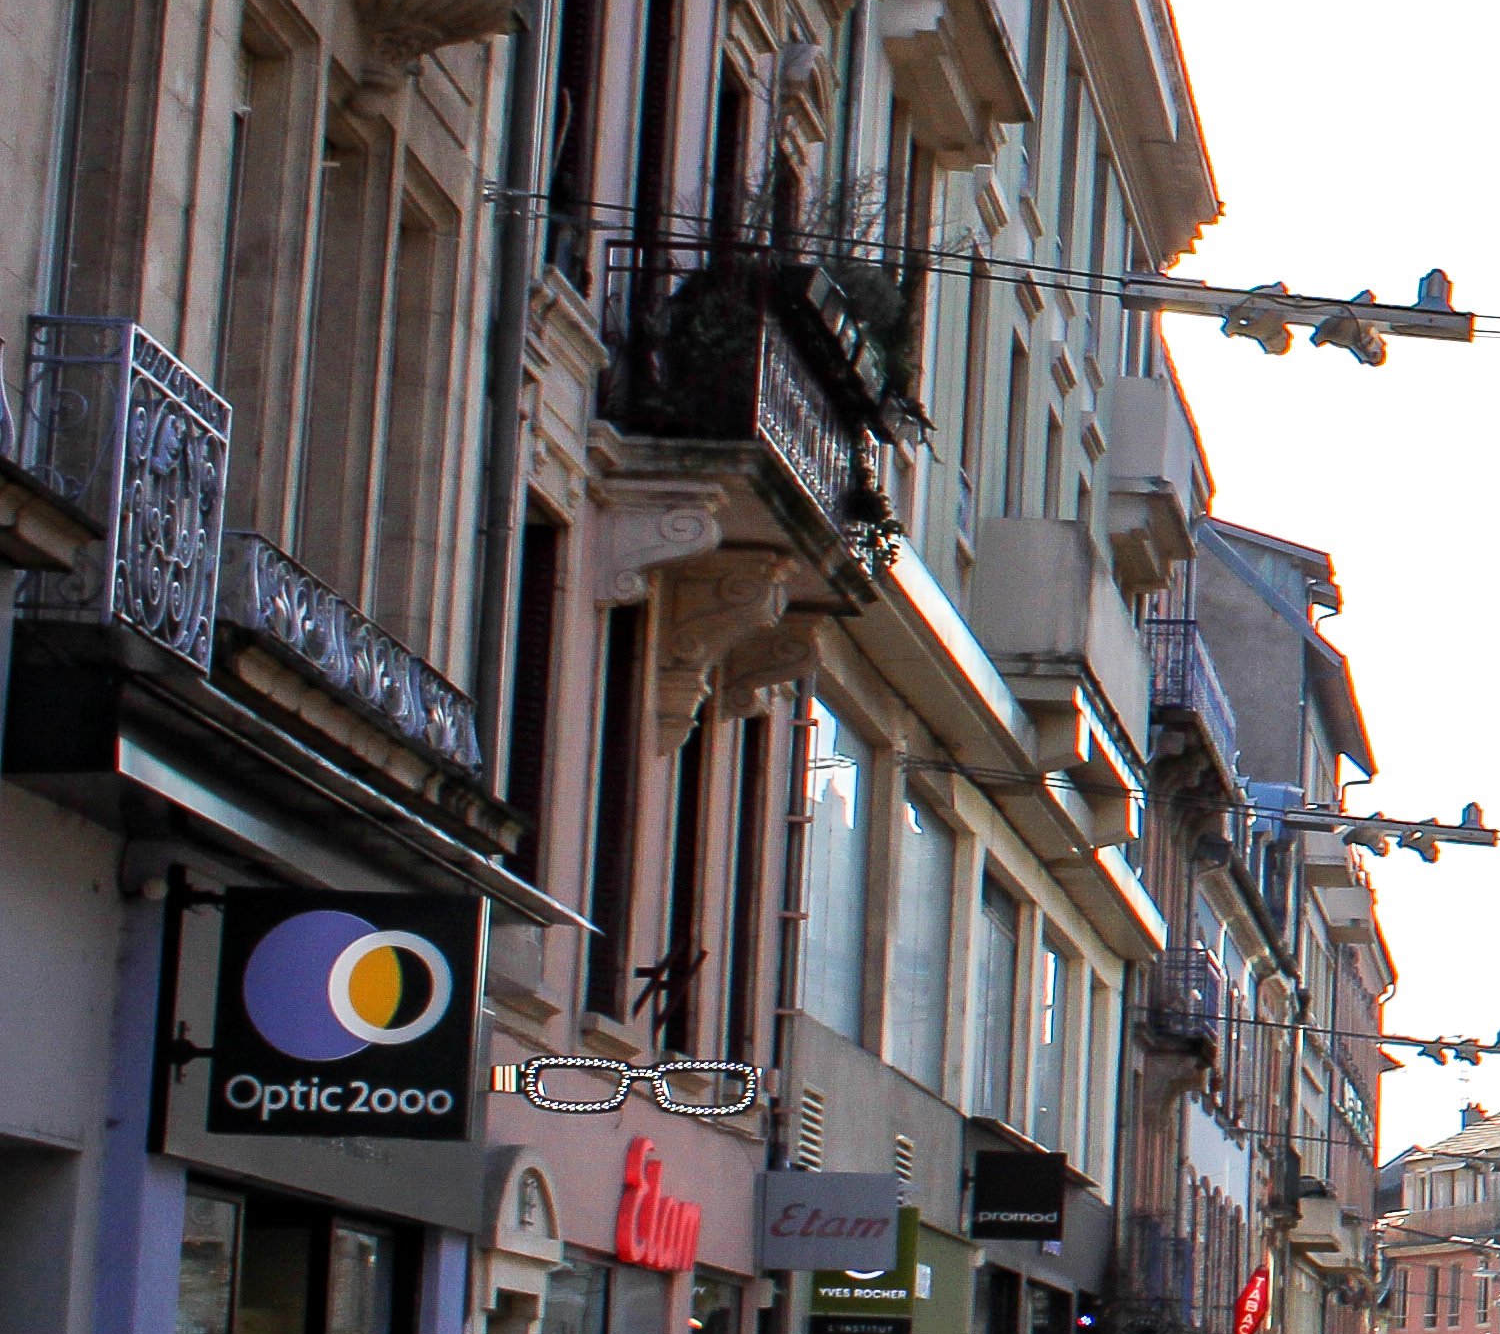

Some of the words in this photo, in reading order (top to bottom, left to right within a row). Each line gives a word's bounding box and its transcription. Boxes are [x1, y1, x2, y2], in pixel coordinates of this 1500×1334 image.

[225, 1074, 344, 1121] Optic
[348, 1081, 454, 1115] 2000
[770, 1202, 890, 1239] Etam
[978, 1211, 1059, 1223] promod
[819, 1287, 852, 1299] YVES
[853, 1288, 908, 1300] ROCHER
